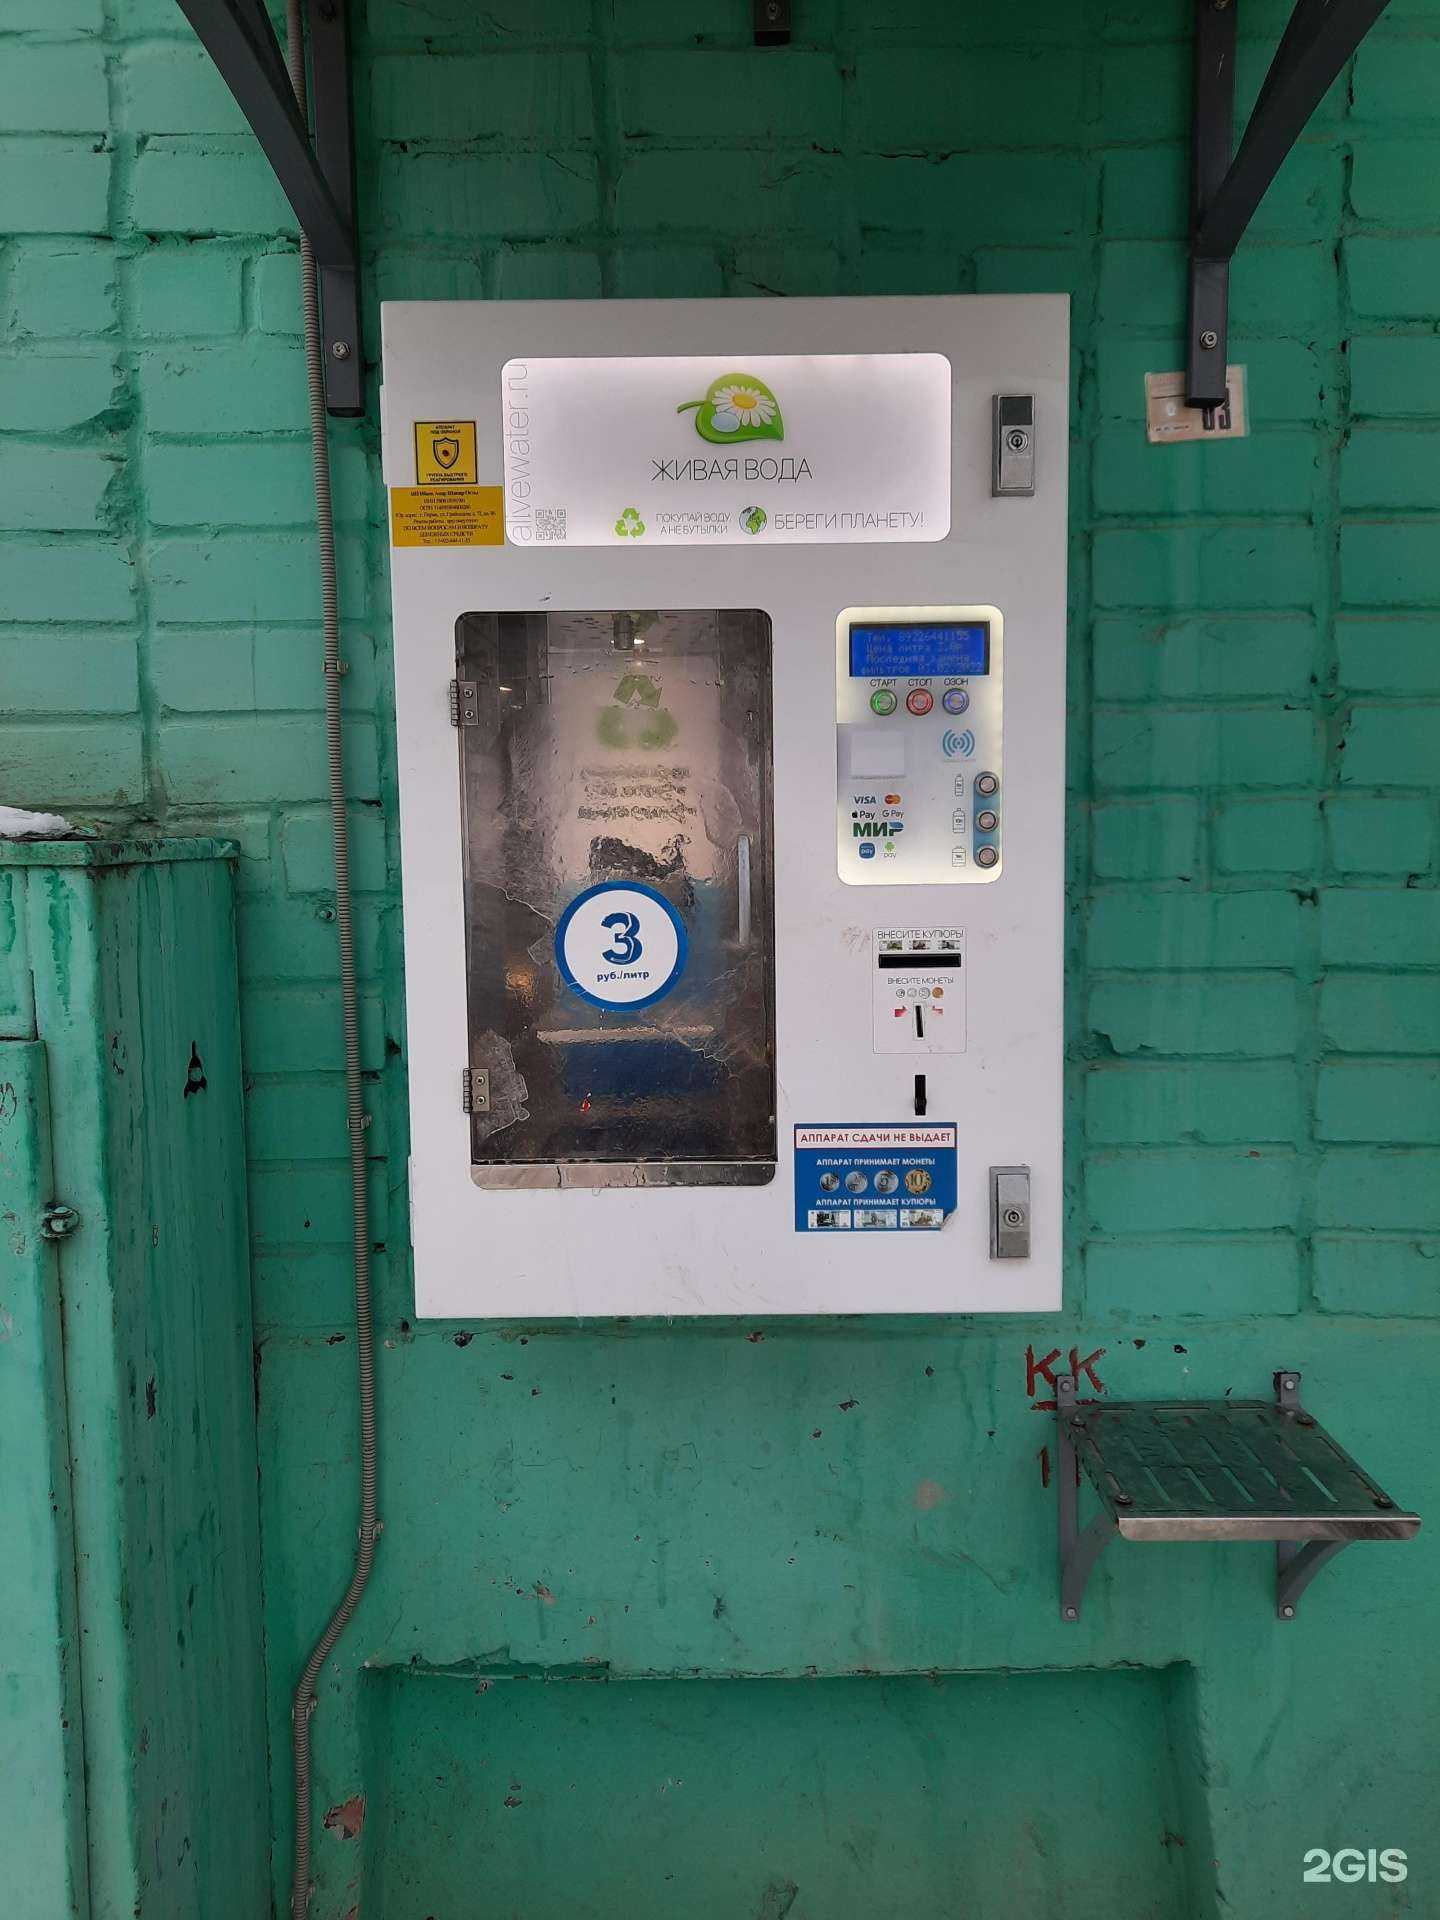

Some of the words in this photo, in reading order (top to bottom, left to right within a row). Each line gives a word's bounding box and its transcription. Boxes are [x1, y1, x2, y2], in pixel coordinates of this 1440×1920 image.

[506, 363, 532, 541] alivewater.ru
[651, 458, 738, 481] ЖИВАЯ
[744, 458, 813, 483] ВОДА
[656, 513, 703, 522] ПОКУПАЙ
[774, 513, 837, 530] БЕРЕГИ
[841, 512, 926, 530] ПЛАНЕТУ!
[682, 524, 728, 534] БУТЫЛКИ
[869, 678, 897, 687] СТАРТ
[908, 678, 933, 687] СТОП
[944, 678, 968, 686] ОЗОН
[854, 796, 877, 804] VISA
[859, 811, 876, 820] Pay
[890, 810, 904, 819] Pay
[853, 822, 904, 837] МИР
[877, 930, 921, 939] ВНЕСИТЕ
[922, 929, 963, 939] КУПЮРЫ
[601, 912, 643, 966] 3
[597, 971, 649, 982] руб./литр
[800, 1133, 850, 1142] АППАРАТ
[852, 1133, 890, 1143] СДАЧИ
[893, 1133, 906, 1142] НЕ
[909, 1133, 951, 1142] ВЫДАЕТ
[816, 1158, 852, 1166] АППАРАТ
[854, 1158, 900, 1166] ПРИНИМАЕТ
[901, 1158, 936, 1166] МОНЕТЫ
[815, 1198, 852, 1206] АППАРАТ
[853, 1198, 900, 1206] ПРИНИМАЕТ
[901, 1198, 936, 1206] КУПЮРЫ
